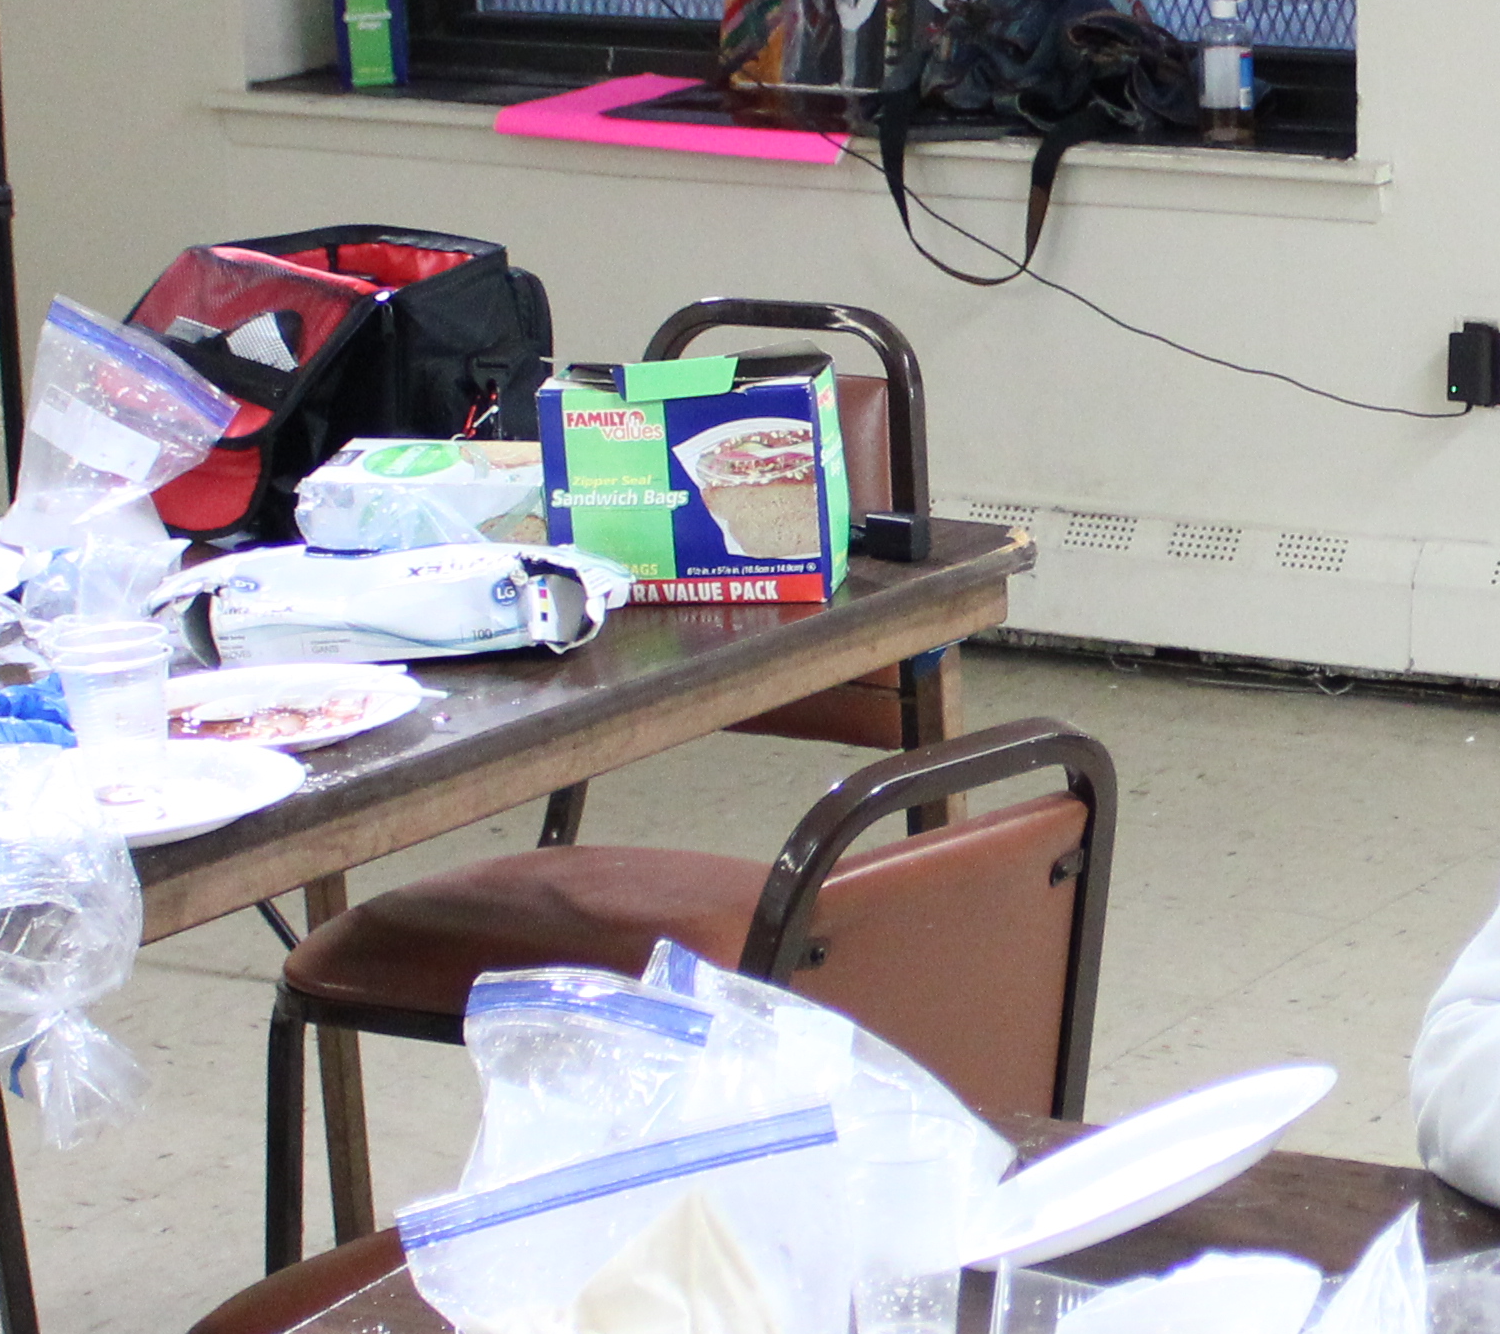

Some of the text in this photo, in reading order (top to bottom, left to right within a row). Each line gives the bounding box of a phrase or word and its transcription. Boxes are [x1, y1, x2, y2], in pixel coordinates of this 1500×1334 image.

[566, 411, 627, 428] FAMILY
[602, 419, 664, 440] values
[572, 474, 653, 487] Zipper Seal
[551, 489, 690, 510] Sandwich Bags
[496, 586, 517, 601] LG
[662, 581, 724, 602] VALUE
[729, 579, 779, 601] PACK
[472, 628, 494, 641] 100
